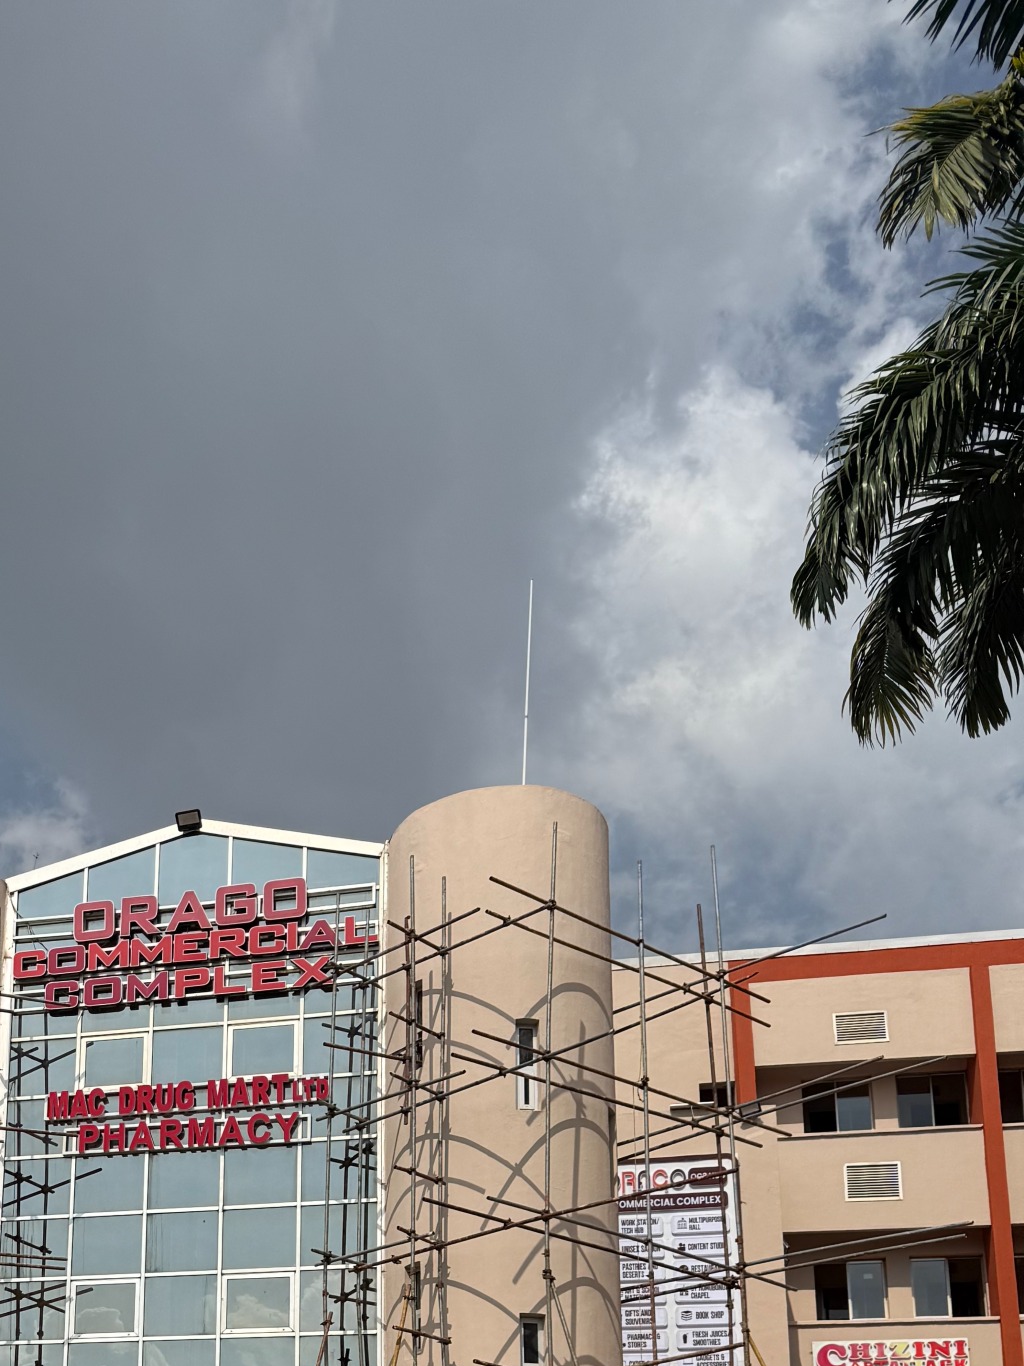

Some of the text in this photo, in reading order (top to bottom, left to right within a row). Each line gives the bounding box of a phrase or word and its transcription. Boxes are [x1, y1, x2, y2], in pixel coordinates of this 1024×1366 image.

[73, 877, 307, 942] ORAGO
[13, 916, 378, 979] COMMERCIAL
[45, 955, 334, 1010] COMPLEX
[47, 1073, 328, 1120] MAC DRUG MART LTD
[78, 1112, 299, 1153] PHARMACY
[617, 1195, 721, 1209] OMMERCIAL COMPLEX
[636, 1217, 660, 1226] STAON/
[689, 1216, 724, 1224] MULTIPURPOS
[634, 1226, 644, 1234] HUB
[621, 1245, 640, 1253] UNISEX
[687, 1242, 709, 1251] CONTENT
[622, 1263, 647, 1271] PASTRIES
[622, 1271, 645, 1279] DESERTS
[690, 1291, 711, 1299] CHAPEL
[695, 1310, 725, 1320] BOOK SHOP
[627, 1333, 654, 1341] PHARMAC
[692, 1330, 708, 1338] FRESH
[692, 1338, 721, 1347] SMOOTHIES
